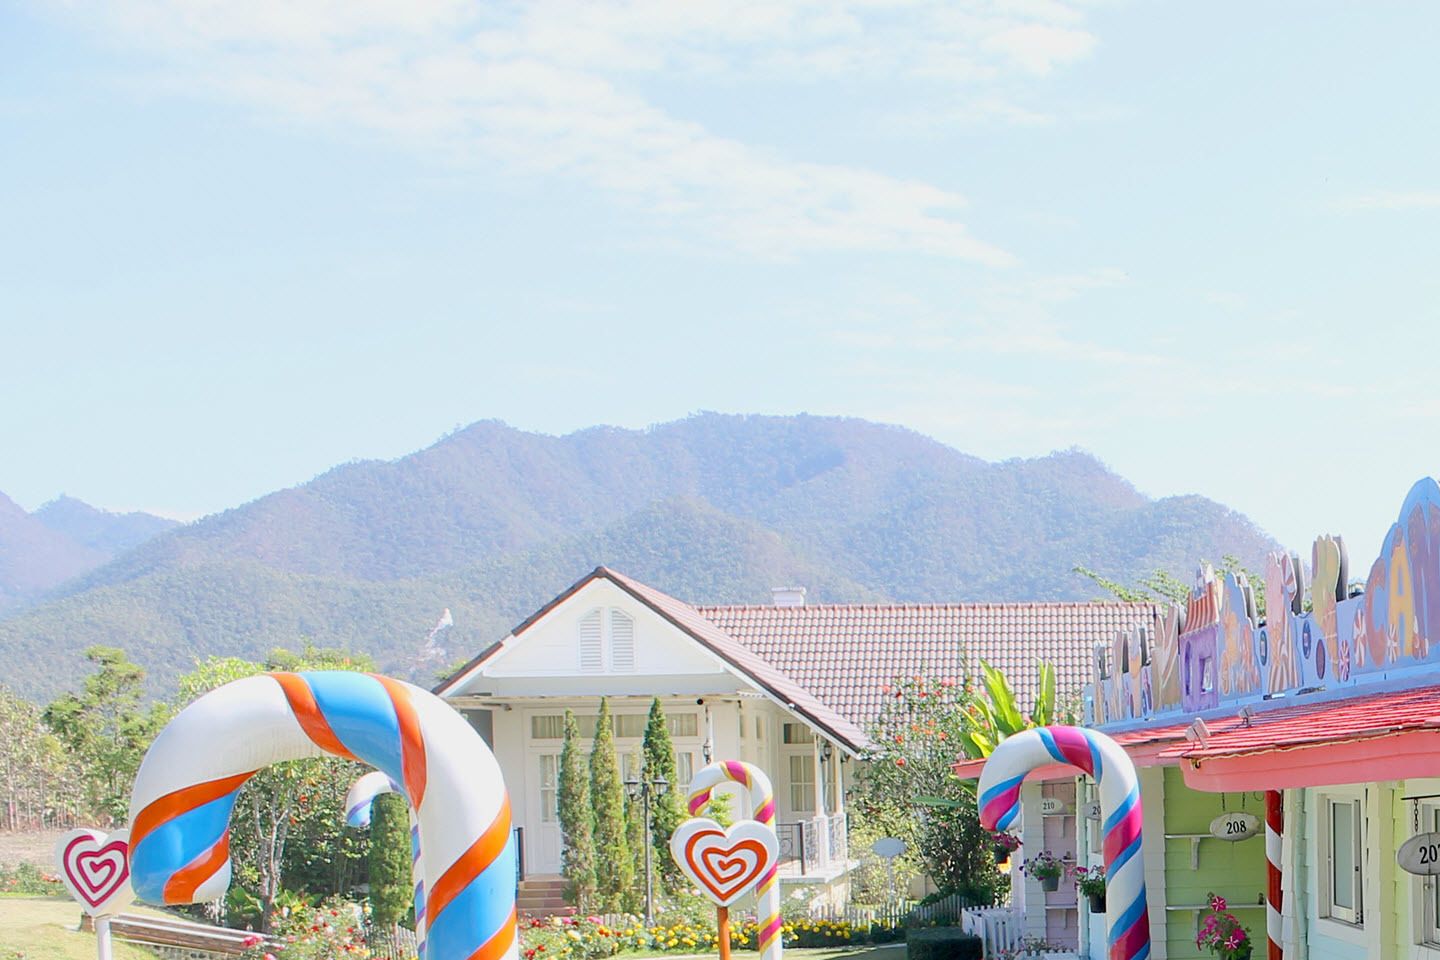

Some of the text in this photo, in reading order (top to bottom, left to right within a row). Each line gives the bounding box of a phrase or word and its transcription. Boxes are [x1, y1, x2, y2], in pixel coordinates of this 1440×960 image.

[1042, 801, 1055, 811] 210
[1092, 804, 1102, 816] 20
[1226, 820, 1247, 835] 208
